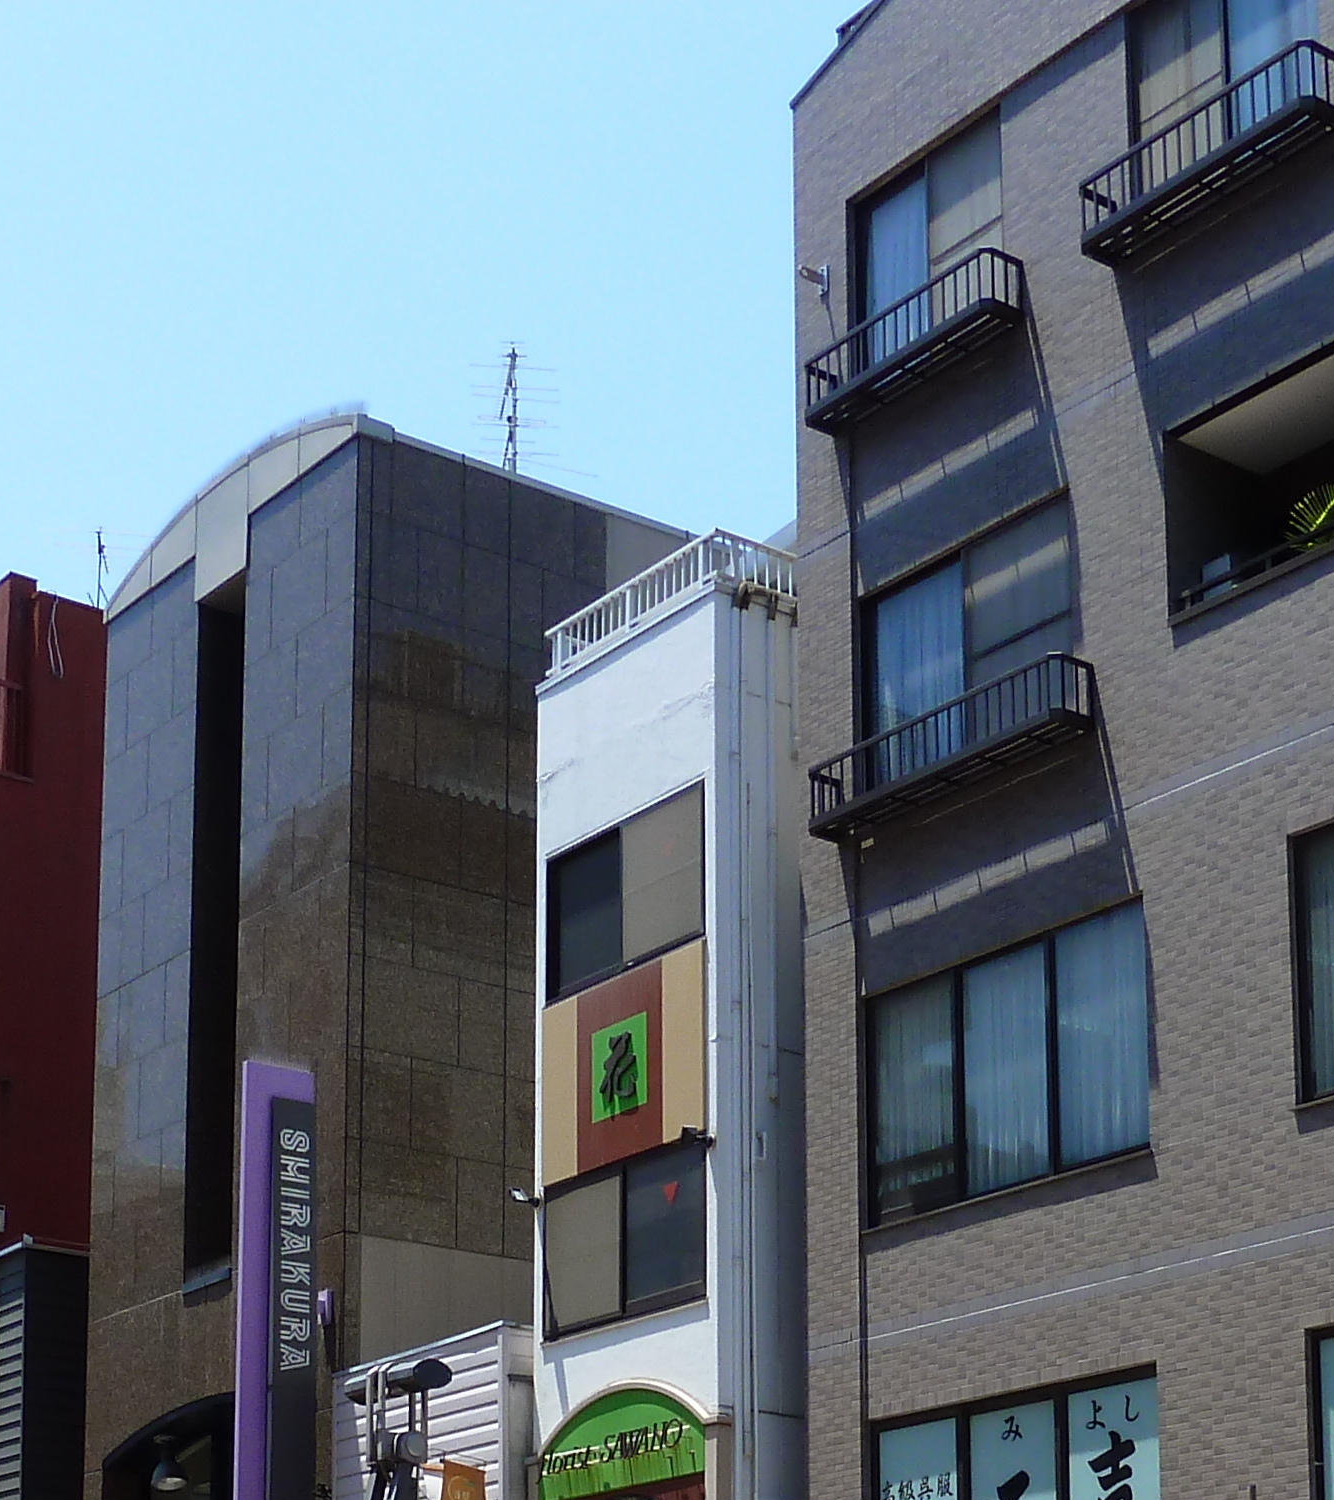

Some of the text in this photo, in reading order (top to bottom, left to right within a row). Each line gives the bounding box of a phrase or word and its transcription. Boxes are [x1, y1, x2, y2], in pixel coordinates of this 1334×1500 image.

[279, 1128, 311, 1371] SHIRAKURA
[599, 1418, 684, 1463] SAWANO
[1000, 1394, 1140, 1442] みよし
